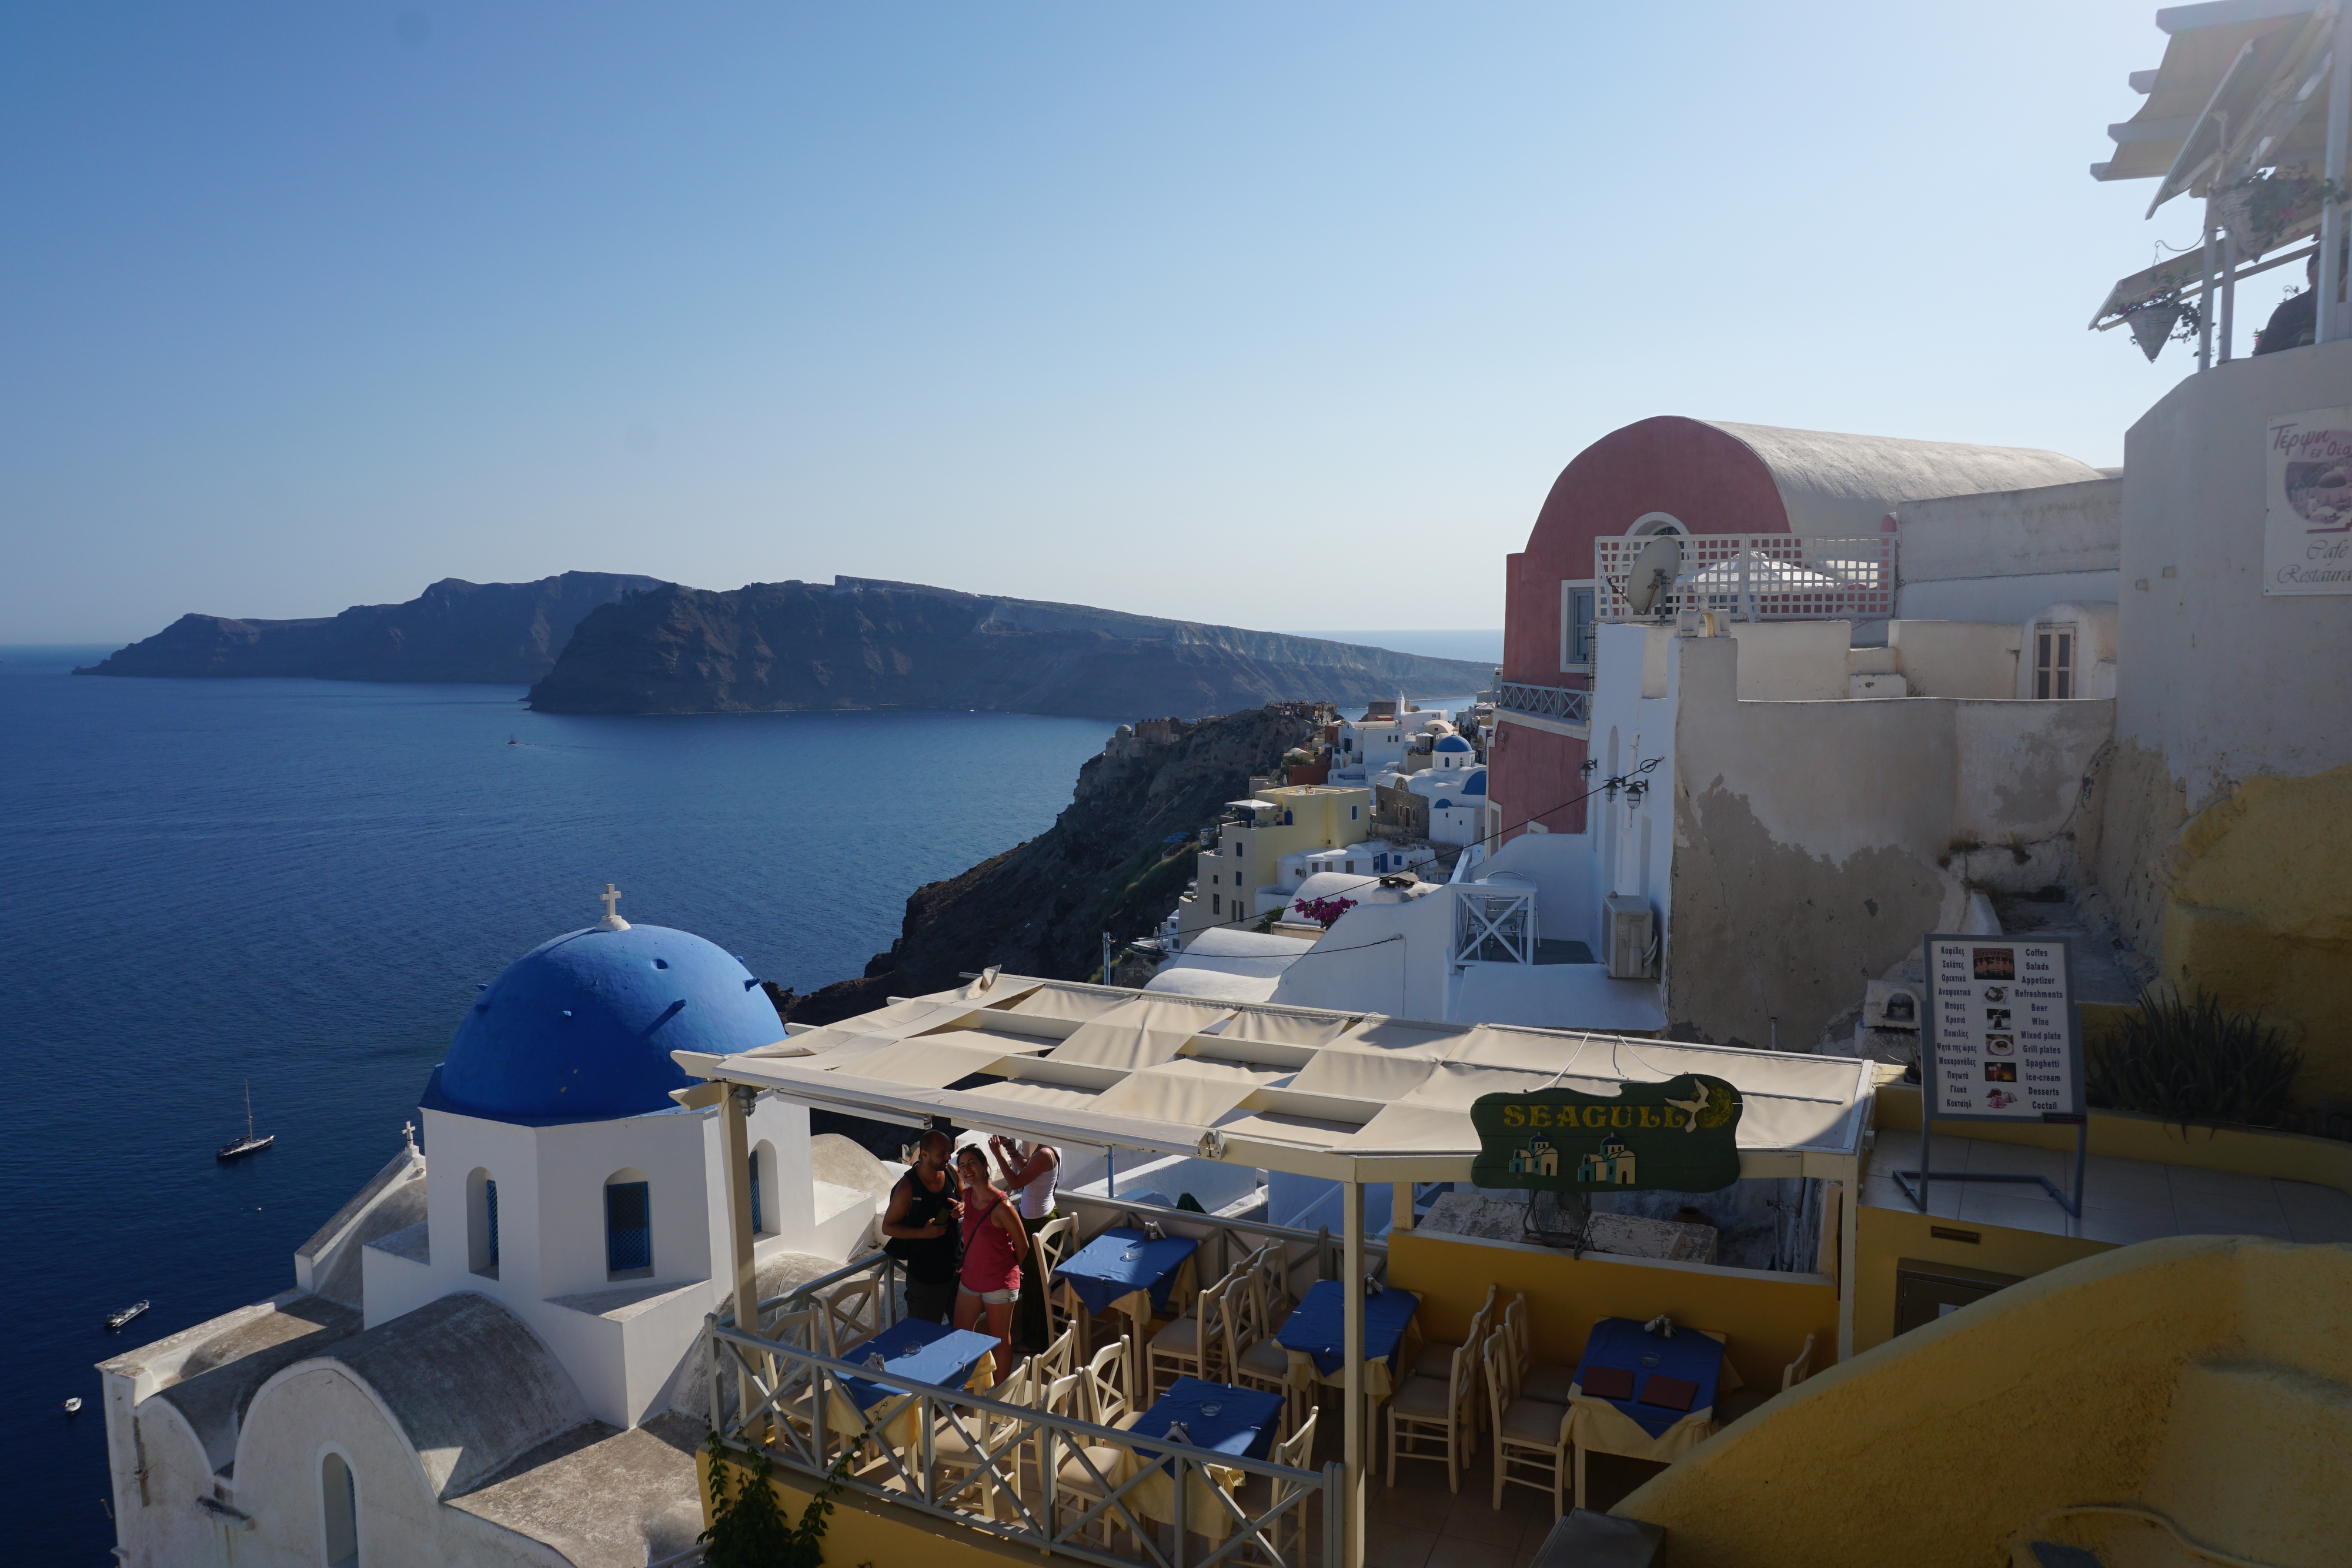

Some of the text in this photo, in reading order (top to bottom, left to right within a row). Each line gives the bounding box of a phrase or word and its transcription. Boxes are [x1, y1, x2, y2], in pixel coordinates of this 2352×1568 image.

[2307, 539, 2349, 566] Cafe
[1941, 947, 1965, 956] Καφέδες
[2026, 948, 2047, 957] Coffes
[1943, 961, 1964, 970] Σαλάτες
[1942, 974, 1966, 983] Ορεκτικά
[2022, 976, 2054, 985] Appetizer
[1939, 988, 1971, 998] Αναψυκτικά
[2015, 989, 2063, 998] Refreshments
[1945, 1002, 1965, 1011] Μπύρες
[1946, 1015, 1965, 1025] Κρασιά
[2032, 1017, 2049, 1025] Wine
[1944, 1029, 1969, 1039] Ποικιλίες
[2044, 1032, 2061, 1041] plate
[1937, 1043, 1977, 1053] Ψητά της ώρας
[2023, 1045, 2060, 1055] Grill plates
[1939, 1057, 1976, 1067] Μακαρονάδες
[2026, 1059, 2059, 1069] Spaghetti
[1947, 1071, 1969, 1081] Παγωτά
[2026, 1073, 2060, 1082] Ice-cream
[2029, 1087, 2059, 1095] Desserts
[1947, 1099, 1972, 1109] Κοκταίηλ
[2033, 1101, 2057, 1109] Coctail
[1504, 1105, 1686, 1128] SEAGULL
